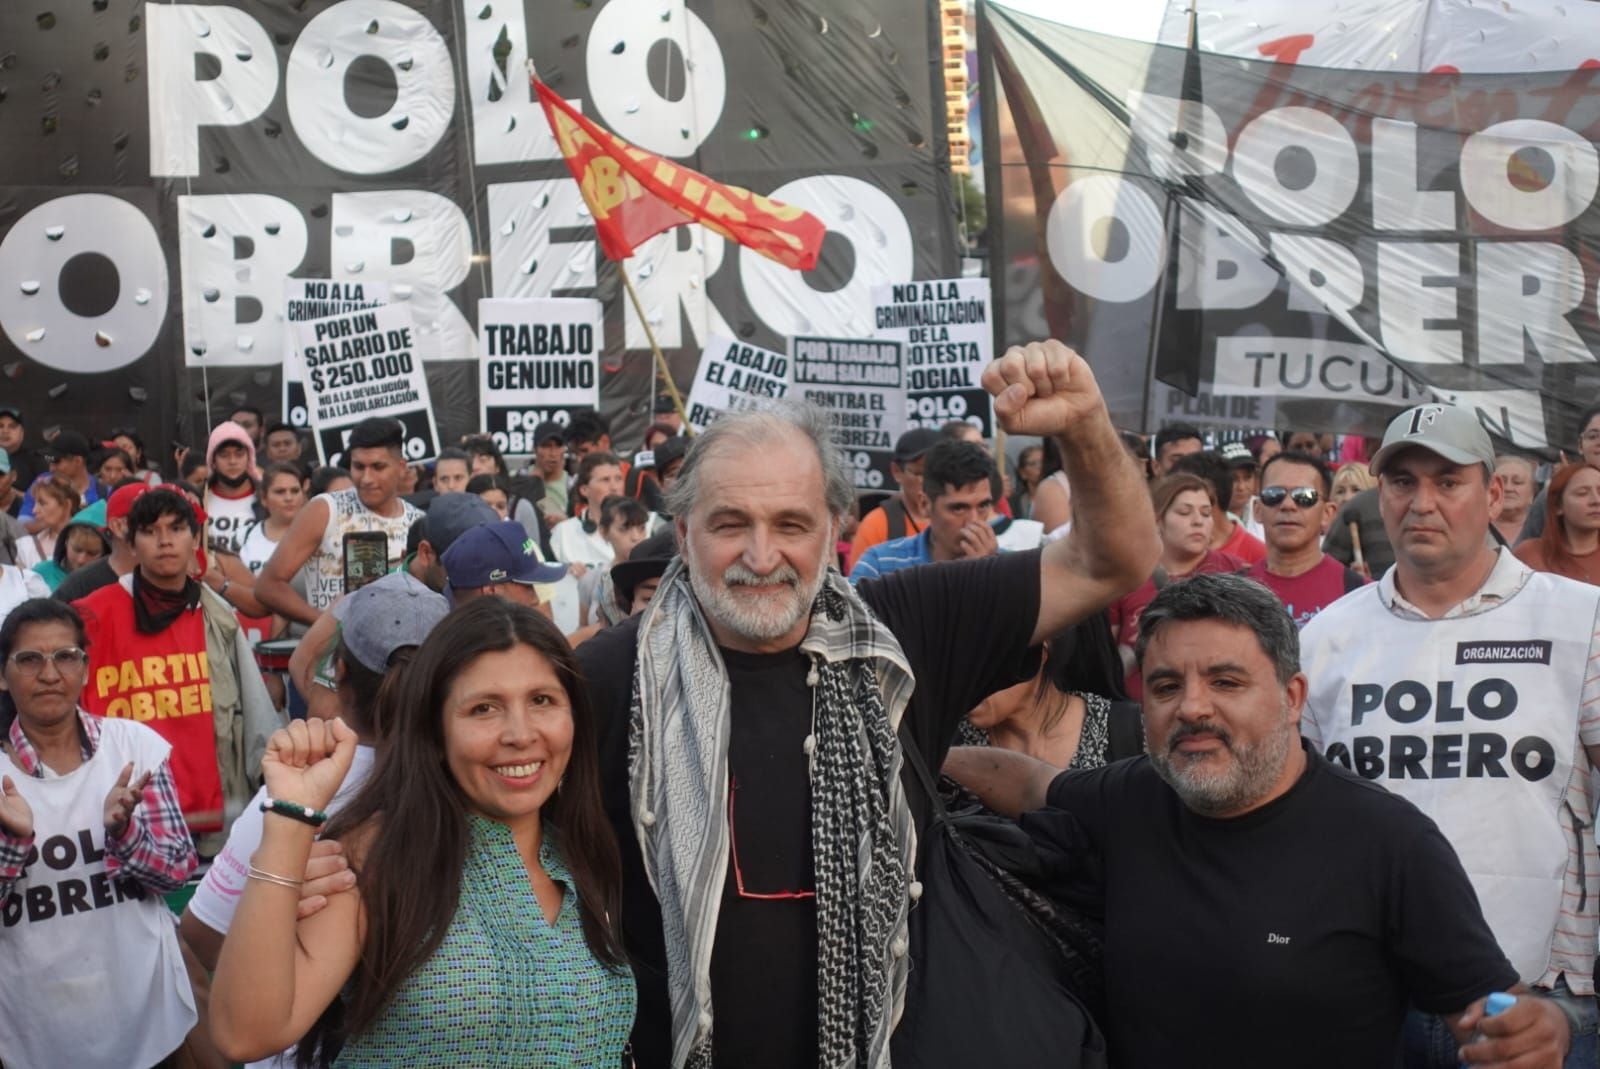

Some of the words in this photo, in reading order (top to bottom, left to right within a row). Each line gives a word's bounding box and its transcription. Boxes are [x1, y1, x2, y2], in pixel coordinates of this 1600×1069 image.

[145, 0, 725, 178] POLO
[1128, 89, 1599, 230] POLO
[0, 173, 913, 373] OBRERO
[1046, 174, 1600, 366] OBRER
[305, 282, 327, 299] NO
[331, 283, 341, 299] A
[345, 284, 364, 301] LA
[892, 284, 918, 303] NO
[922, 283, 933, 301] A
[937, 282, 960, 300] LA
[315, 318, 352, 341] POR
[352, 312, 378, 335] UN
[876, 296, 986, 329] CRIMINALIZACIÓN
[304, 333, 386, 367] SALARIO
[387, 327, 413, 352] DE
[484, 323, 593, 356] TRABAJO
[909, 327, 928, 343] DE
[931, 326, 949, 342] LA
[725, 342, 787, 379] ABAJO
[907, 342, 981, 366] OTESTA
[488, 360, 594, 390] GENUINO
[704, 361, 725, 386] EL
[728, 368, 788, 399] AJUST
[870, 393, 887, 411] EL
[906, 394, 967, 420] POLO
[1231, 395, 1261, 420] DE
[1463, 643, 1543, 660] ORGANIZACIÓN
[96, 651, 208, 698] PARTI
[1351, 678, 1518, 726] POLO
[1324, 731, 1556, 782] OBRERO
[1267, 932, 1290, 945] Dior
